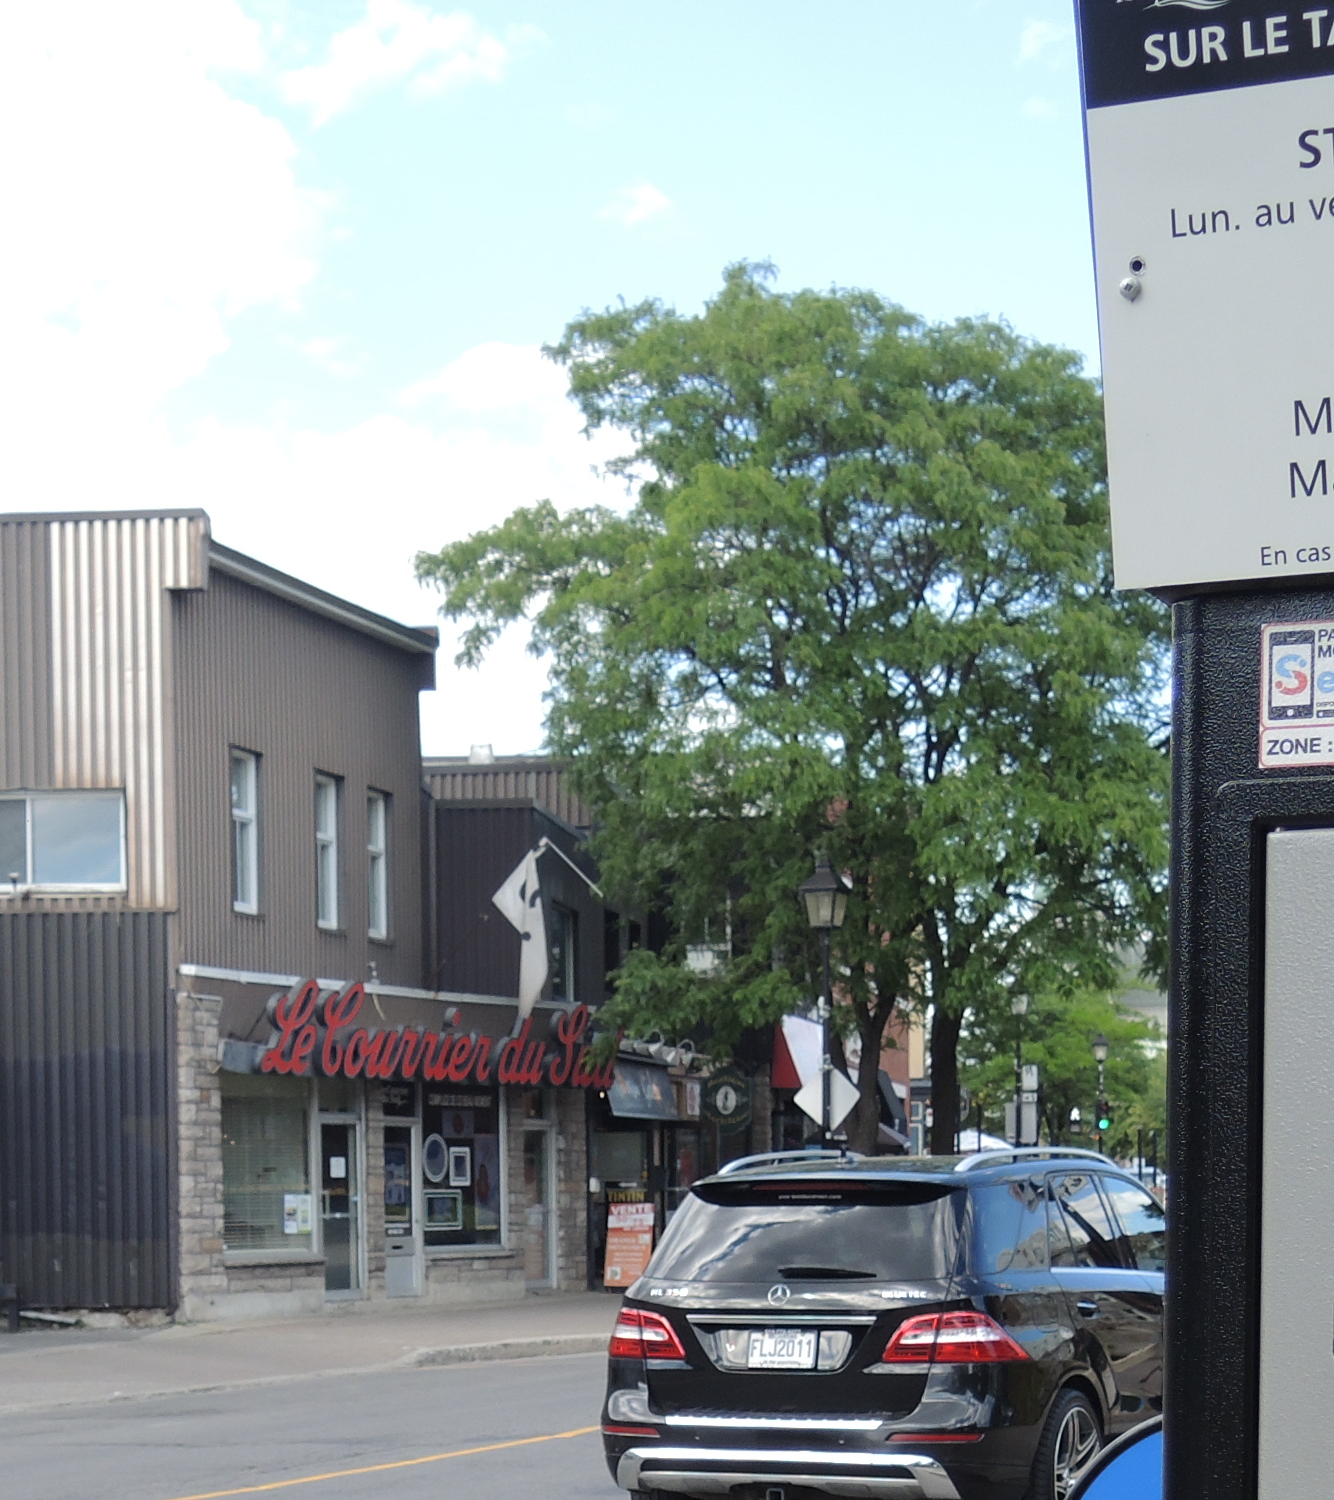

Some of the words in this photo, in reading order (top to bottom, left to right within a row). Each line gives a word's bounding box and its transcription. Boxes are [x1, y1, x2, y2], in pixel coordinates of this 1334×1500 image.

[1144, 25, 1228, 72] SUR
[1242, 15, 1290, 58] LE
[1170, 208, 1241, 239] Lun.
[1255, 200, 1295, 229] au
[1260, 545, 1287, 567] En
[1295, 544, 1331, 565] cas
[1267, 737, 1322, 756] ZONE
[262, 979, 317, 1074] Le
[322, 982, 491, 1082] Courrier
[498, 1016, 547, 1084] du
[610, 1204, 650, 1216] VENTE
[750, 1339, 812, 1358] FLJ2011
